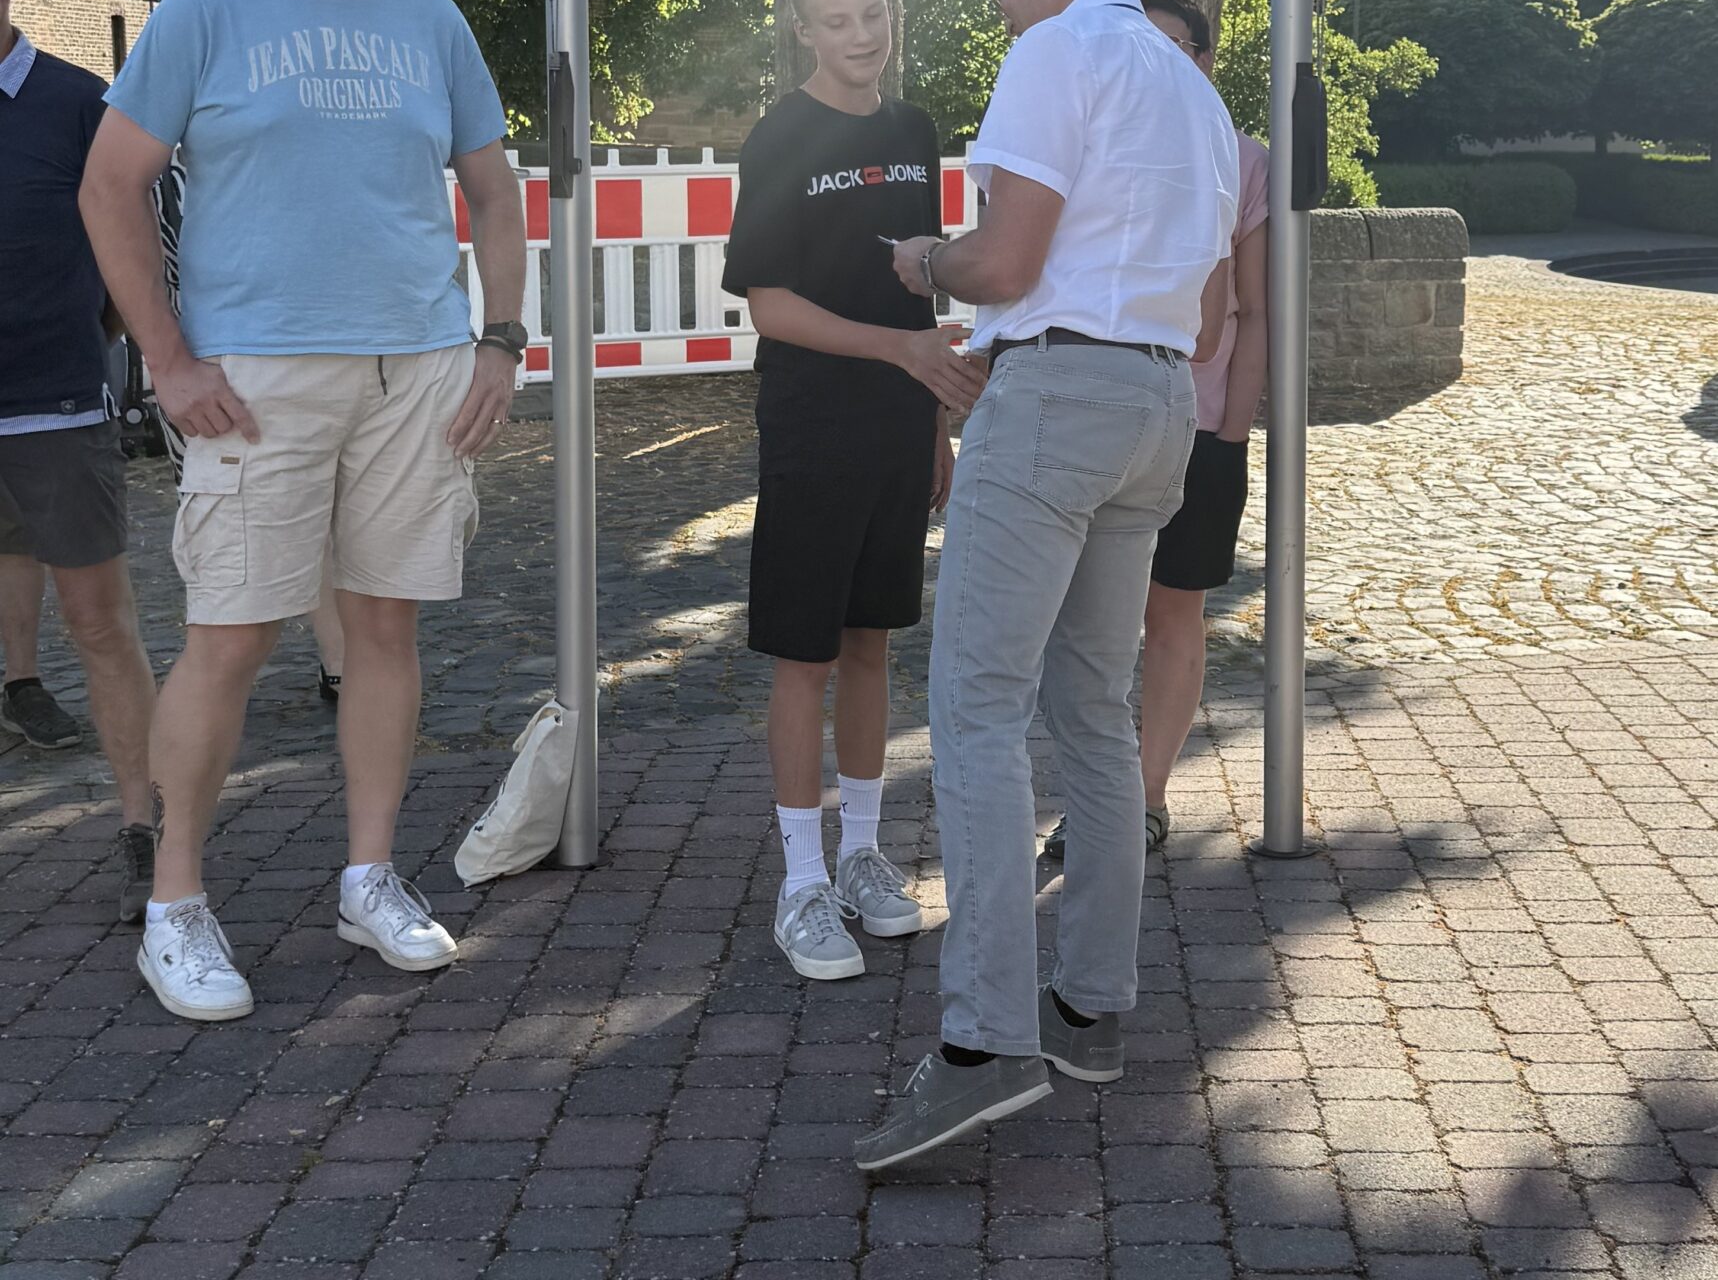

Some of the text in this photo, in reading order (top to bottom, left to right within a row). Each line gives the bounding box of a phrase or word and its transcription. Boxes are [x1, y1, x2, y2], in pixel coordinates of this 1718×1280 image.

[248, 26, 430, 93] JEAN PASCALE
[299, 78, 402, 110] ORIGINALS
[320, 111, 387, 121] TRADEMARK
[807, 164, 928, 196] JACK JONES
